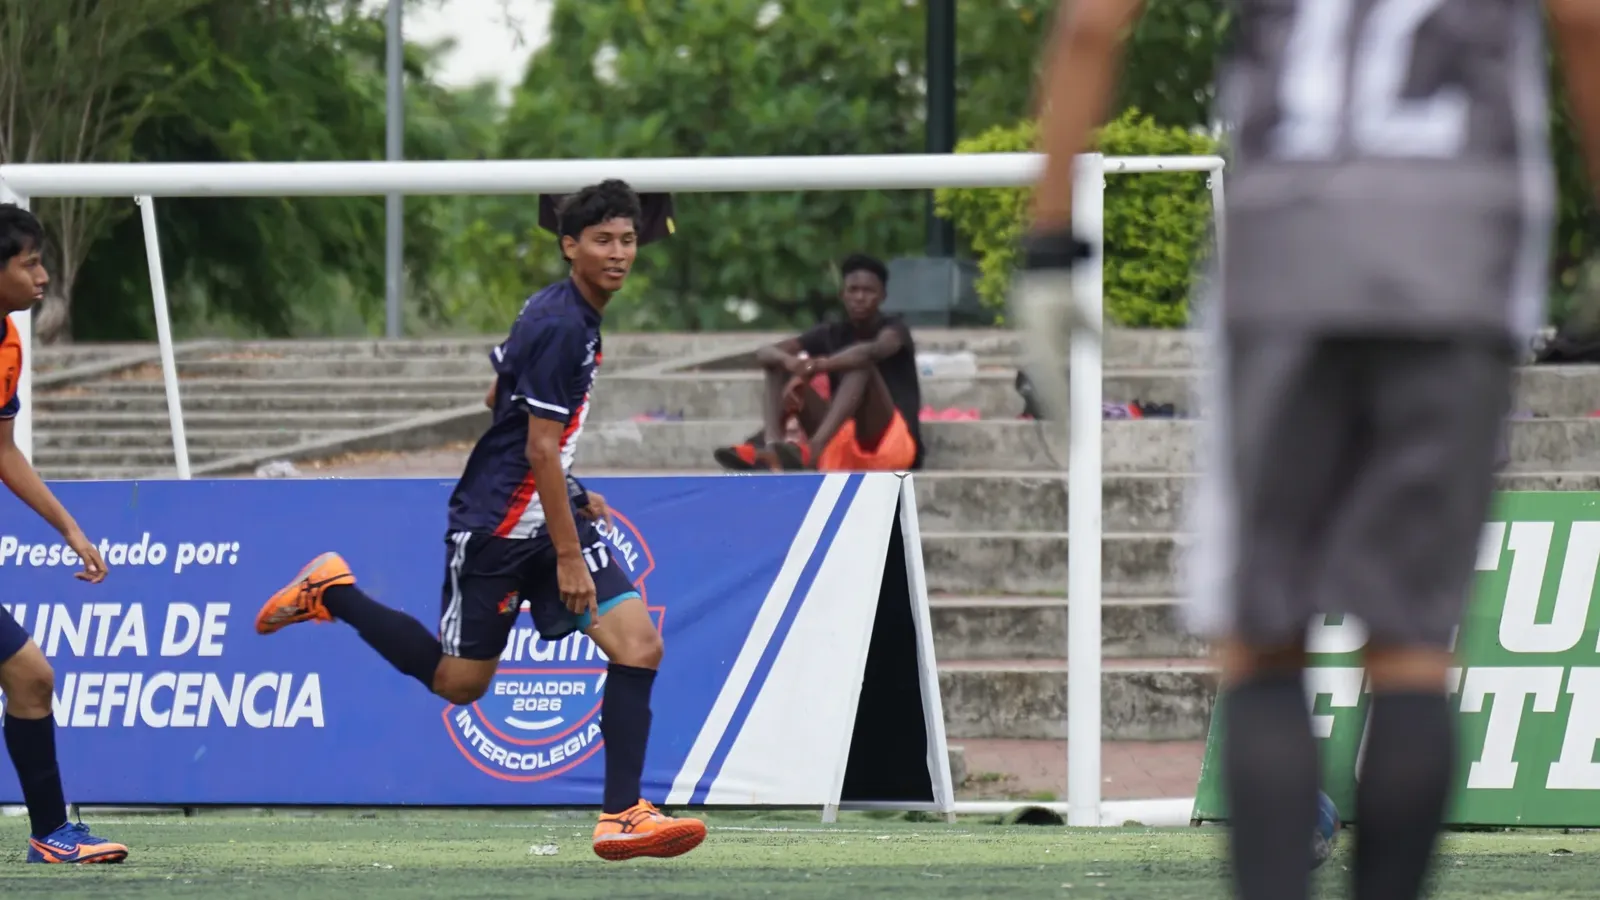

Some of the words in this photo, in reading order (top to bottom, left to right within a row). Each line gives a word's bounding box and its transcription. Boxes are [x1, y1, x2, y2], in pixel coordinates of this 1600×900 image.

[174, 541, 240, 573] por:
[2, 603, 148, 656] UNTA
[160, 603, 230, 656] DE
[494, 682, 586, 695] ECUADOR
[512, 698, 562, 711] 2026
[456, 709, 602, 770] INTERCOLEGIA
